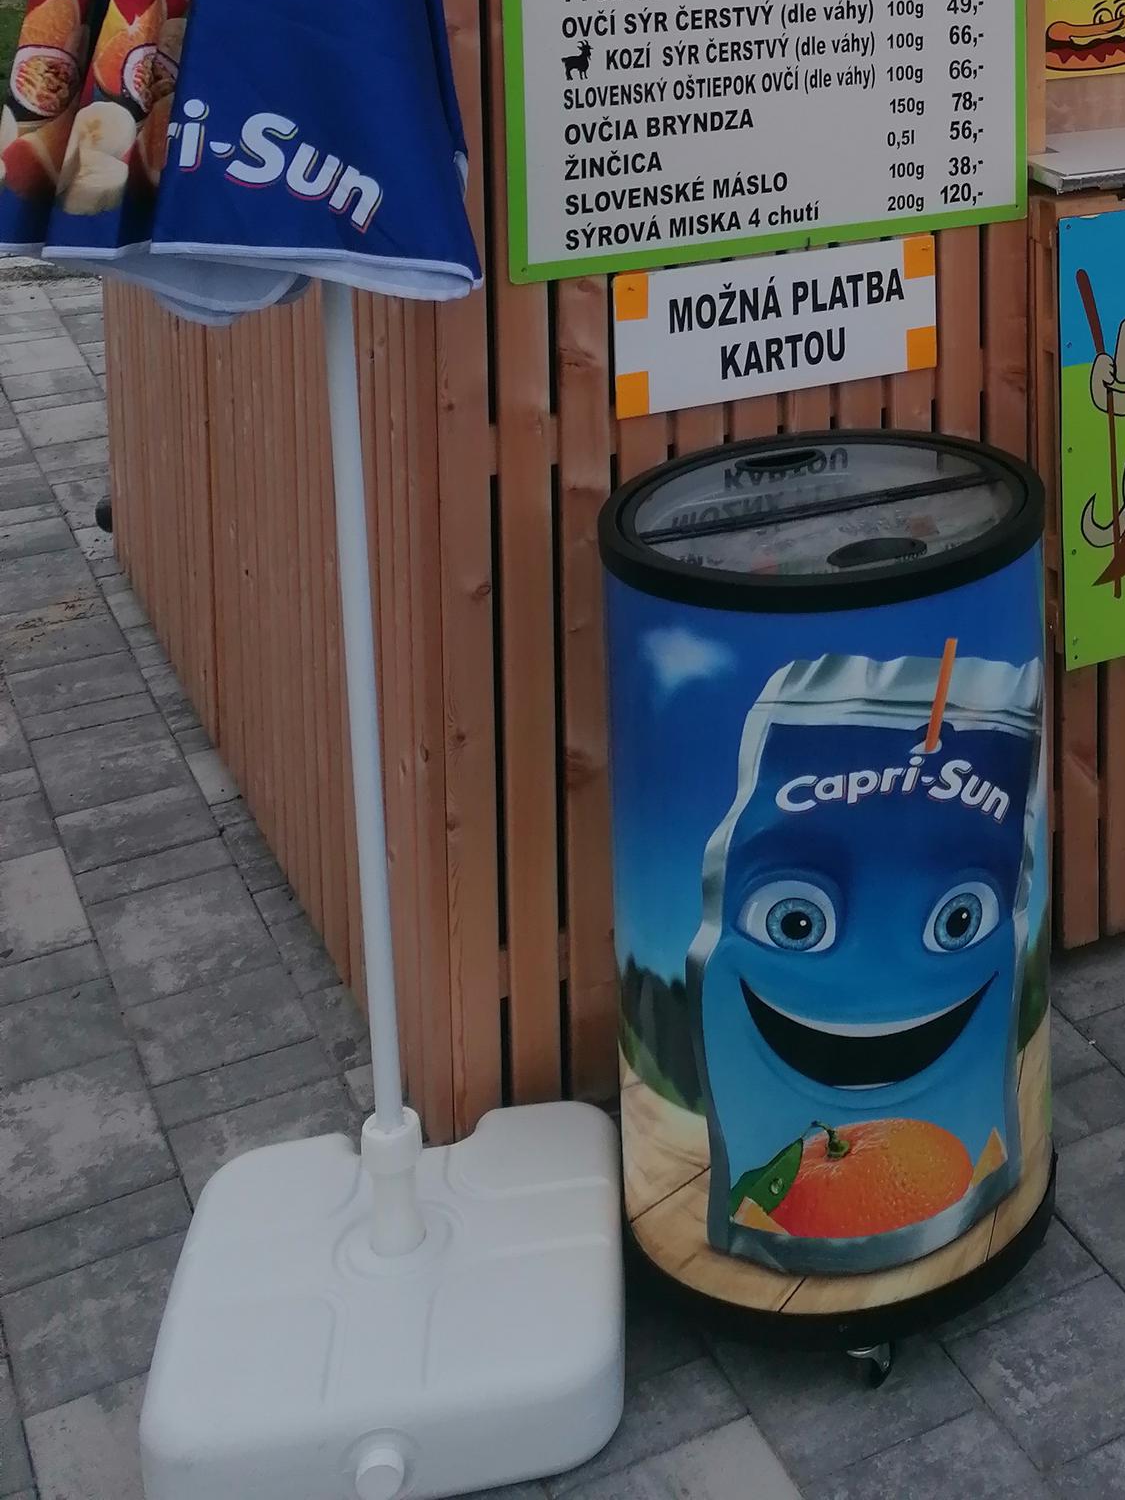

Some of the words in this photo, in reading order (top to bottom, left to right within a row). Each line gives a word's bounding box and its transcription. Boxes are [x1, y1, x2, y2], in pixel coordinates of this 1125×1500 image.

[561, 8, 616, 39] OVČÍ
[624, 6, 668, 35] SÝR
[675, 0, 774, 32] ČERSTVÝ
[780, 1, 818, 30] (dle
[605, 43, 651, 70] KOZÍ
[663, 40, 700, 67] SÝR
[706, 33, 790, 64] ČERSTVÝ
[949, 25, 984, 48] 66,-
[563, 76, 667, 110] SLOVENSKÝ
[673, 67, 756, 100] OŠTIEPOK
[762, 60, 800, 92] OVČÍ
[949, 59, 984, 83] 66,-
[564, 111, 639, 146] OVČIA
[646, 108, 754, 139] BRYNDZA
[889, 98, 925, 116] 150g
[952, 92, 984, 115] 78,-
[564, 151, 663, 180] ŽINČICA
[886, 129, 915, 149] 0,5l
[949, 120, 984, 144] 56,-
[565, 176, 705, 216] SLOVENSKÉ
[712, 170, 788, 202] MÁSLO
[889, 162, 925, 181] 100g
[948, 156, 984, 179] 38,-
[565, 214, 662, 251] SÝROVÁ
[669, 209, 741, 239] MISKA
[747, 207, 760, 229] 4
[768, 200, 820, 227] chutí
[887, 193, 925, 213] 200g
[940, 184, 984, 207] 120,-
[668, 276, 782, 334] MOŽNÁ
[792, 268, 904, 315] PLATBA
[720, 326, 846, 380] KARTOU
[775, 755, 1011, 824] Capri-Sun
